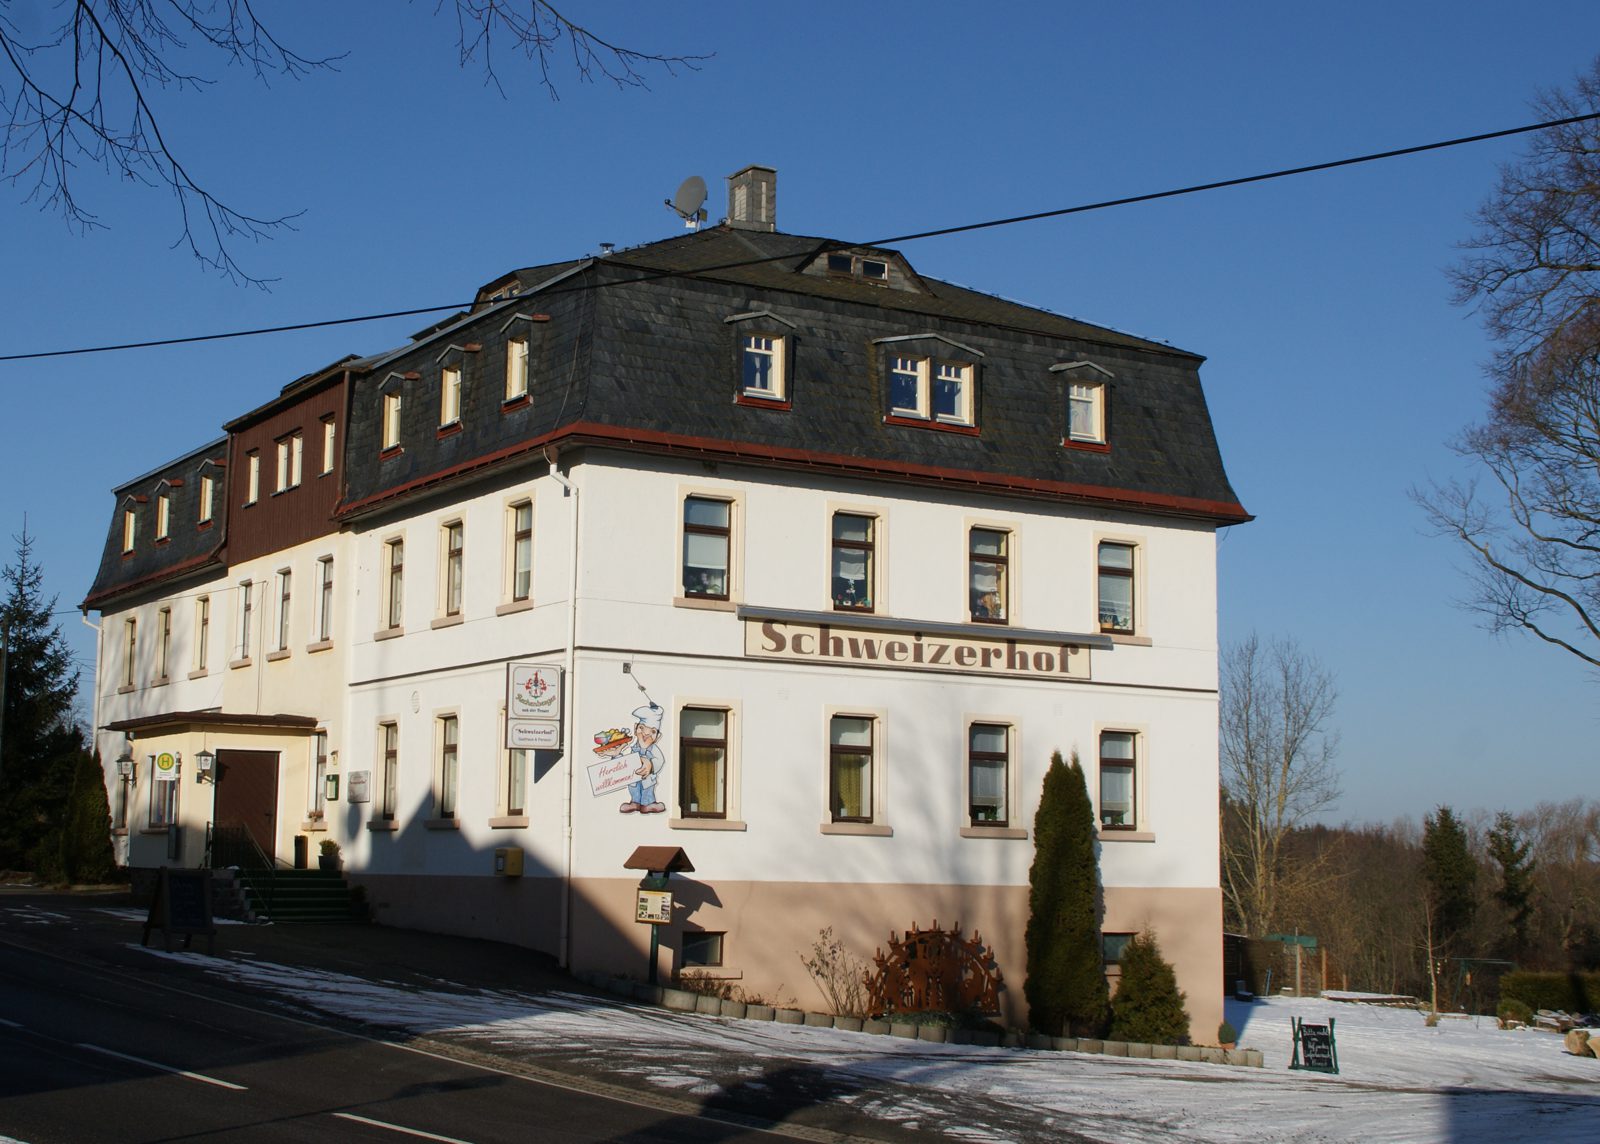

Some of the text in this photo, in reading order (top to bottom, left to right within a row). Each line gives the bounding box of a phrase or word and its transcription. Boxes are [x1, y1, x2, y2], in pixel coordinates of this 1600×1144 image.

[761, 618, 1079, 673] Schweizerhof
[162, 757, 170, 766] H
[598, 760, 628, 777] Herzlich
